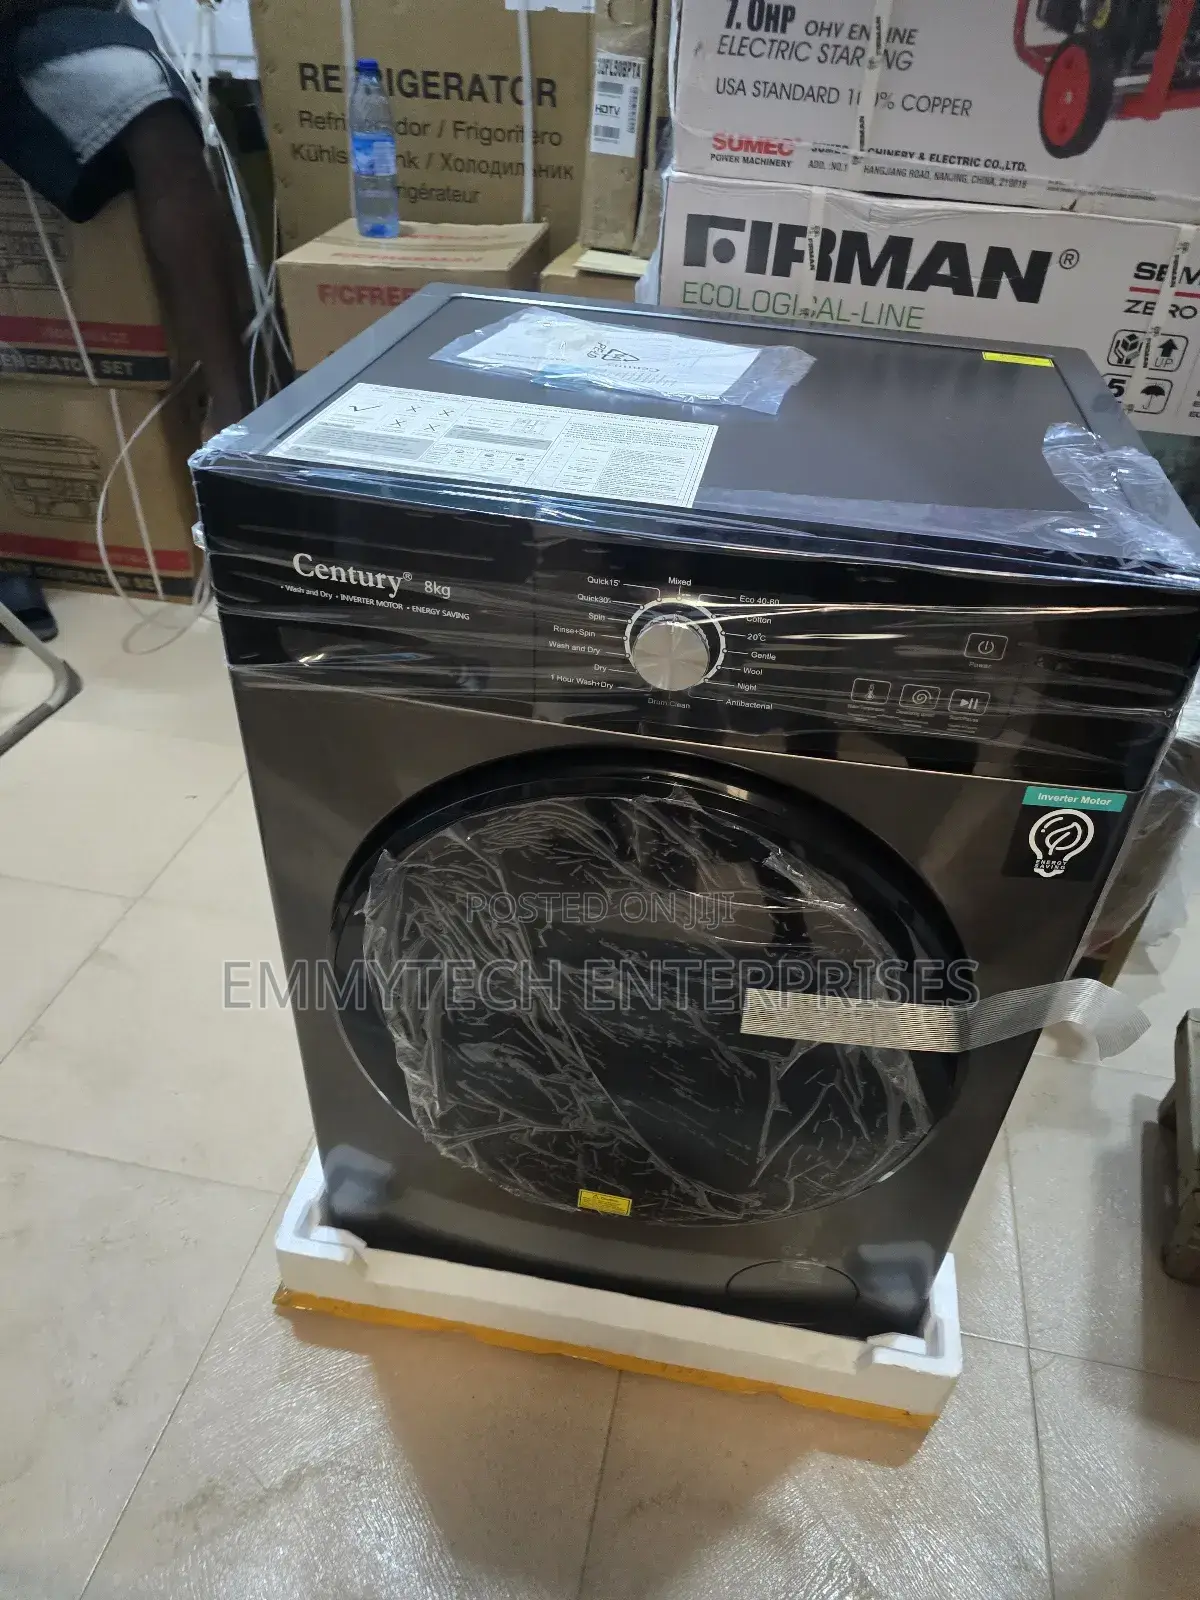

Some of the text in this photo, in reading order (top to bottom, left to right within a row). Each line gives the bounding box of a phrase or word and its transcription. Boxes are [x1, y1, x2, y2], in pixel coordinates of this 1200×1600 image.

[725, 0, 919, 46] 7.0HP OHV ENINE
[716, 34, 915, 71] ELECTRIC STARNG
[298, 62, 557, 108] REIGERATOR
[715, 77, 747, 97] USA
[752, 80, 840, 105] STANDARD
[901, 94, 972, 117] COPPER
[595, 104, 621, 116] HDTV
[710, 153, 793, 168] POWER MACHINERY
[929, 153, 982, 168] ELECTRIC
[683, 281, 925, 330] ECOLOGIAL-LINE
[101, 360, 134, 376] SET
[1154, 357, 1174, 368] UP
[668, 576, 692, 587] Mixed
[424, 580, 451, 600] 8kg
[284, 583, 470, 621] Wash and Dry INVERTER MOTOR ENERGY SAVING
[739, 594, 755, 604] Eco
[588, 612, 606, 621] Spin
[553, 625, 596, 638] Rinse+Spin
[549, 641, 601, 656] Wash and Dry
[751, 652, 776, 661] Gentle
[594, 663, 607, 673] Dry
[743, 667, 763, 676] Wool
[557, 675, 574, 684] Hour
[576, 677, 614, 690] Wash+Dry
[737, 682, 757, 693] Night
[647, 697, 691, 710] Drum Clean
[725, 699, 773, 710] Antibacterial
[1037, 792, 1112, 806] Inverter Motor
